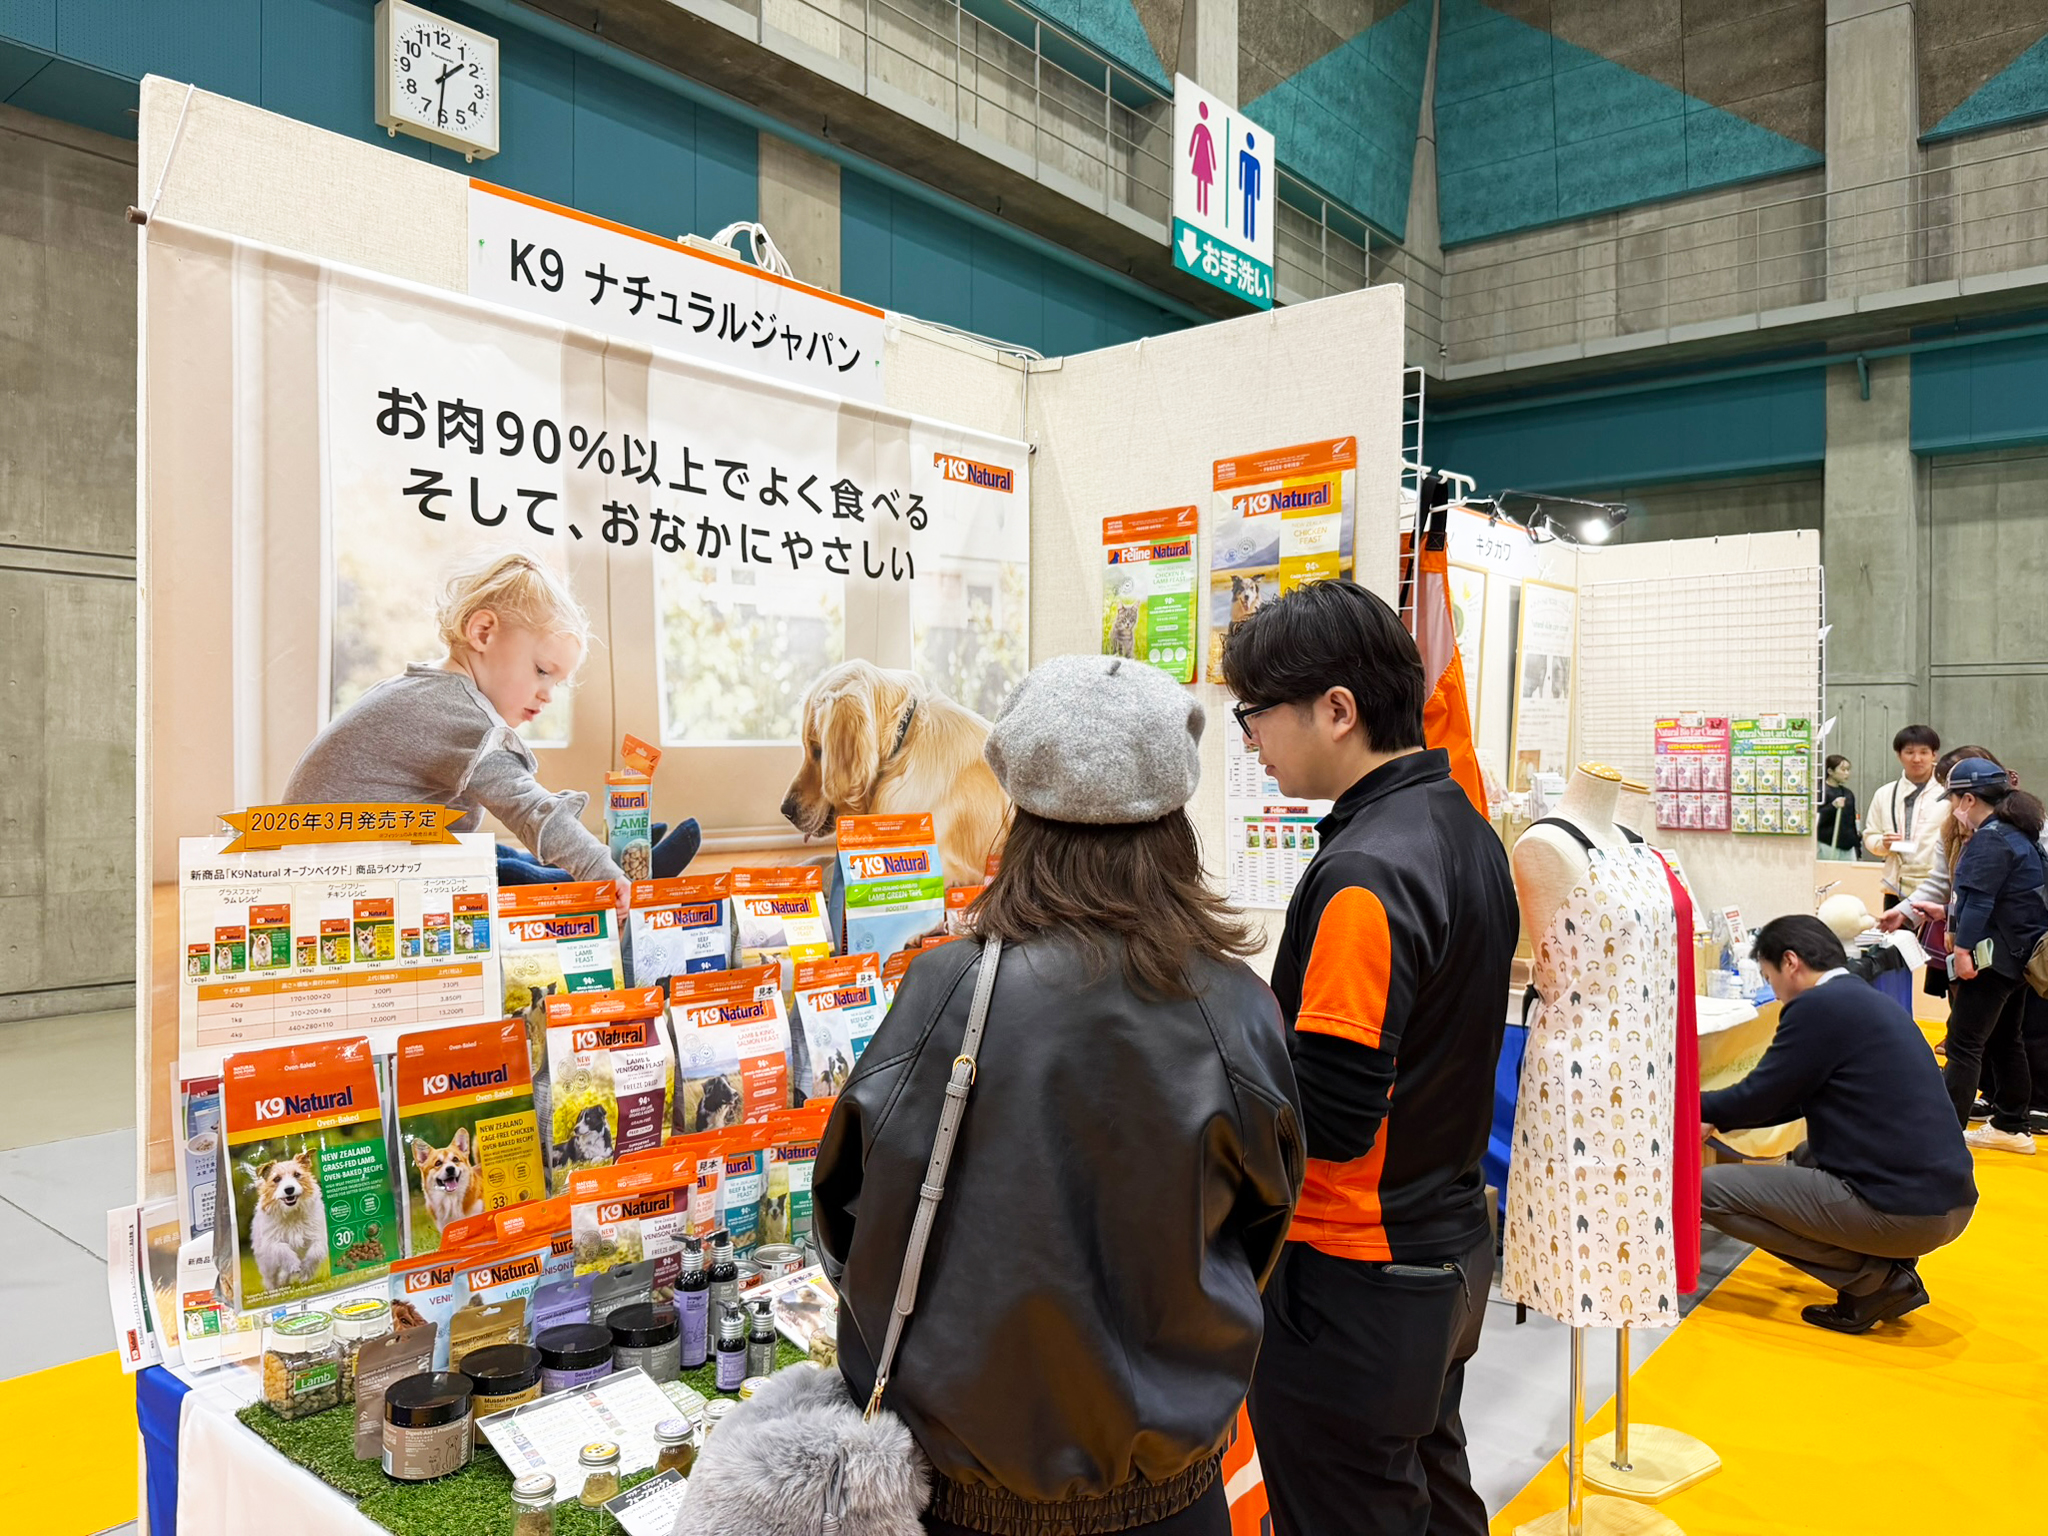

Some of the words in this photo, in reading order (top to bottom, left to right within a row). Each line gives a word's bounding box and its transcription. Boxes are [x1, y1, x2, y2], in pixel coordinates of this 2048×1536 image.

[416, 30, 430, 47] 11
[433, 31, 451, 49] 12
[403, 40, 421, 58] 10
[458, 46, 465, 61] 1
[400, 57, 411, 72] 9
[469, 63, 479, 79] 2
[406, 79, 417, 94] 8
[474, 84, 484, 99] 3
[421, 97, 432, 112] 7
[468, 102, 478, 116] 4
[440, 109, 448, 124] 6
[456, 109, 466, 125] 5
[1202, 240, 1271, 299] お手洗い
[510, 238, 564, 293] K9
[585, 262, 861, 373] ナチュラルジャパン
[375, 385, 930, 533] お肉90%以上でよく食べる
[946, 458, 1012, 491] K9Natural
[1248, 484, 1328, 515] K9Natural
[401, 468, 915, 583] そして、おなかにやさしい
[1294, 527, 1328, 538] CHICKEN
[1299, 536, 1322, 545] FEAST
[1475, 534, 1511, 561] キタガワ
[1121, 547, 1151, 563] Feline
[1153, 542, 1189, 559] Natural
[251, 810, 436, 831] 2026年3月発売予定
[615, 817, 649, 829] LAMB
[865, 852, 927, 875] K9Natural
[190, 867, 281, 881] 新商品「K9Natural
[356, 863, 422, 875] 商品ラインナップ
[755, 898, 809, 915] K9Natural
[655, 906, 713, 927] K9Natural
[524, 917, 595, 940] K9Natural
[758, 986, 774, 997] 見本
[817, 988, 867, 1009] K9Natural
[700, 1001, 765, 1025] K9Natural
[577, 1030, 643, 1050] K9Natural
[736, 1037, 761, 1047] SALMON
[738, 1032, 754, 1040] LAMB
[760, 1028, 775, 1036] KING
[284, 1061, 317, 1072] Oven-Baked
[614, 1064, 644, 1074] VENISON
[626, 1057, 645, 1065] LAMB
[422, 1063, 508, 1096] K9Natural
[255, 1086, 353, 1121] K9Natural
[476, 1089, 514, 1102] Oven-Baked
[317, 1113, 360, 1128] Oven-Baked
[480, 1124, 494, 1133] NEW
[495, 1118, 523, 1131] ZEALAND
[480, 1131, 509, 1142] CAGE-FREE
[510, 1126, 535, 1137] CHICKEN
[482, 1140, 515, 1151] OVEN-BAKED
[516, 1135, 534, 1145] RECIPE
[321, 1150, 338, 1162] NEW
[339, 1146, 372, 1159] ZEALAND
[770, 1142, 819, 1161] 9Natura
[323, 1160, 356, 1173] GRASS-FED
[357, 1155, 376, 1168] LAMB
[699, 1159, 718, 1172] 見本
[324, 1169, 362, 1182] OVEN-BAKED
[363, 1163, 384, 1176] RECIPE
[576, 1179, 597, 1187] NATURAL
[728, 1186, 741, 1195] BEEF
[736, 1190, 752, 1198] FEAST
[601, 1194, 670, 1222] K9Natural
[602, 1227, 614, 1236] NEW
[643, 1230, 671, 1241] VENISON
[654, 1224, 669, 1232] LAMB
[651, 1245, 668, 1255] FREEZE
[409, 1267, 454, 1291] K9Nat
[470, 1257, 540, 1293] K9Natural
[429, 1294, 453, 1306] VENI
[505, 1288, 530, 1300] LAMB
[472, 1331, 493, 1341] Powder
[301, 1372, 331, 1389] Lamb
[484, 1396, 505, 1404] Mussel
[505, 1392, 527, 1402] Powder
[461, 1416, 469, 1465] FOURFLAX
